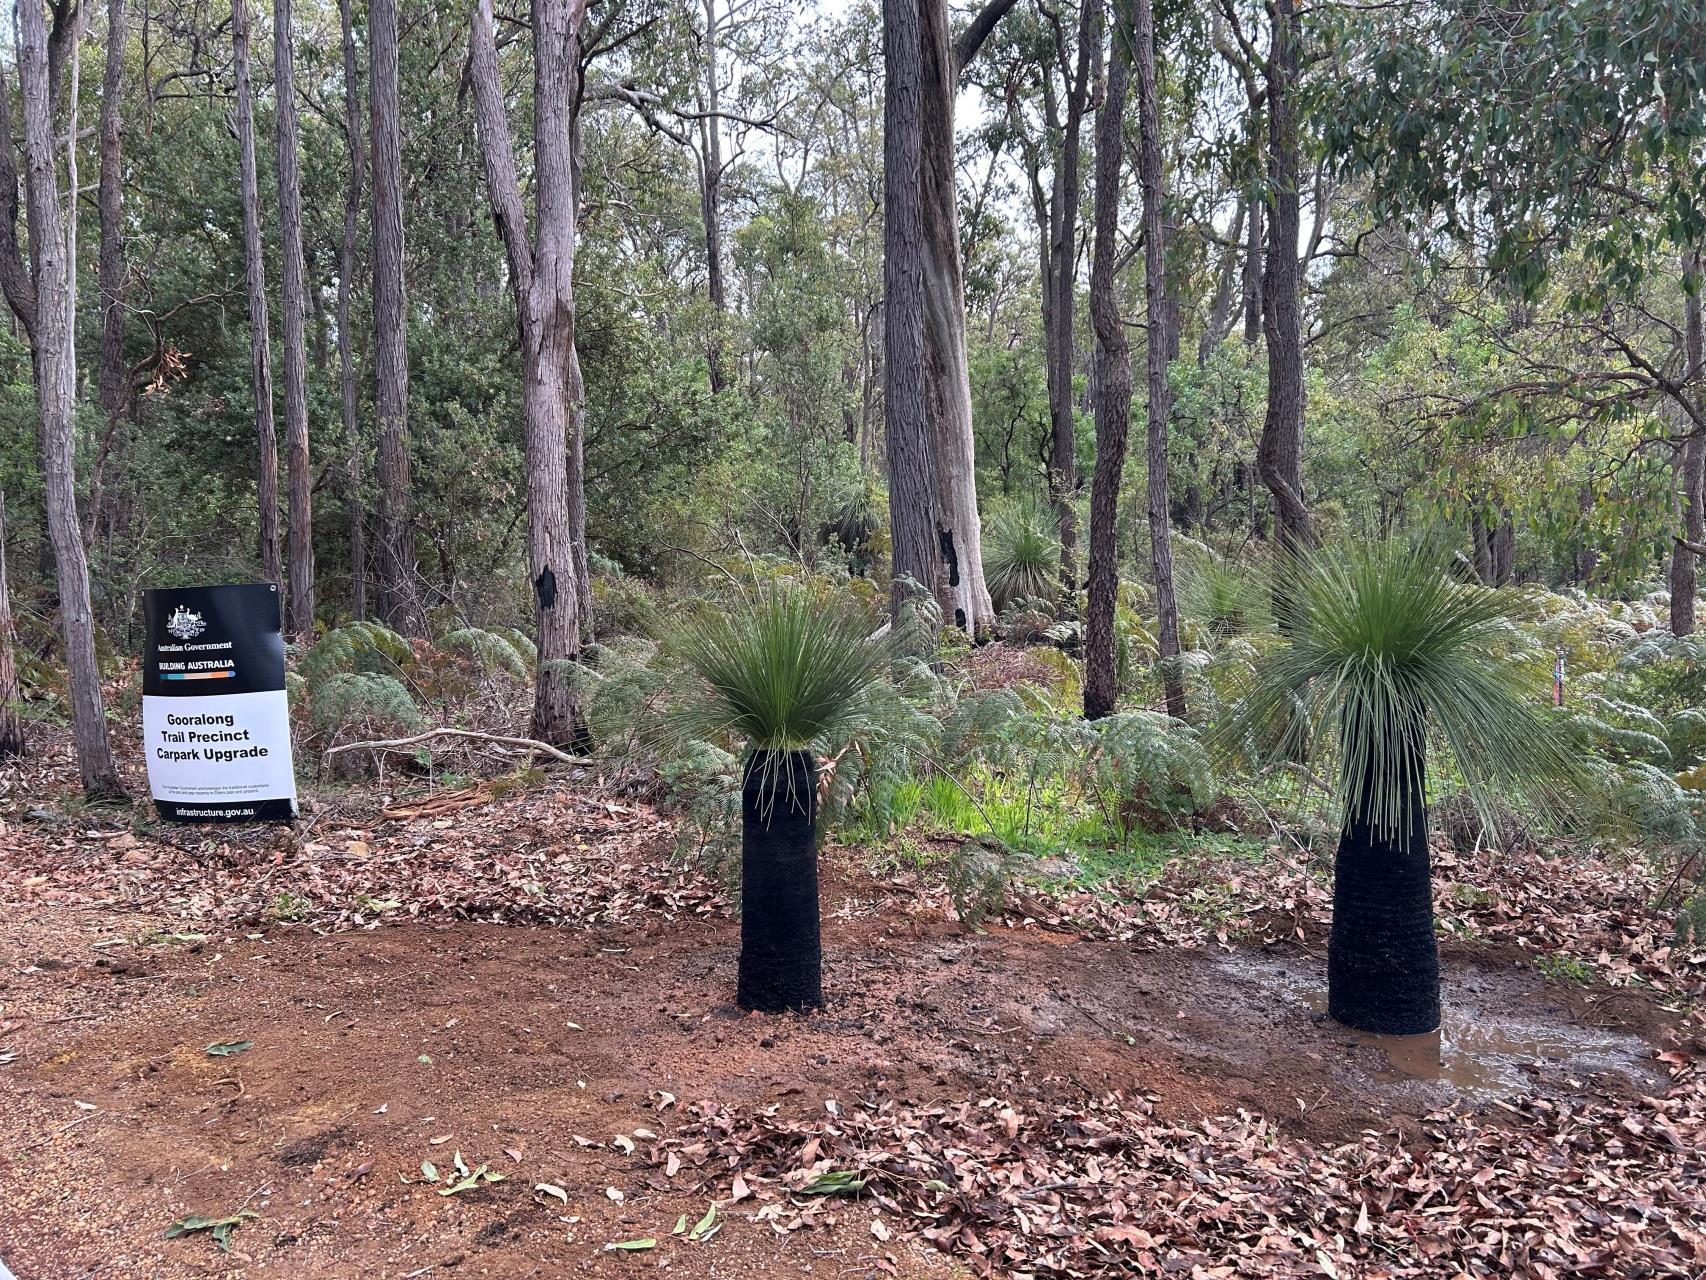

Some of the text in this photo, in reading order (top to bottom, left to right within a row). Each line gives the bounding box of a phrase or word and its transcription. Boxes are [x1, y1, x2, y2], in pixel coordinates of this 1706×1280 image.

[158, 641, 232, 652] Australian Government
[159, 659, 235, 670] BUILDING AUSTRALIA
[167, 713, 234, 727] Gooralong
[161, 729, 250, 743] Trail Precinct
[157, 745, 269, 762] Carpark Upgrade
[175, 807, 254, 818] infrastructure.gov.au
